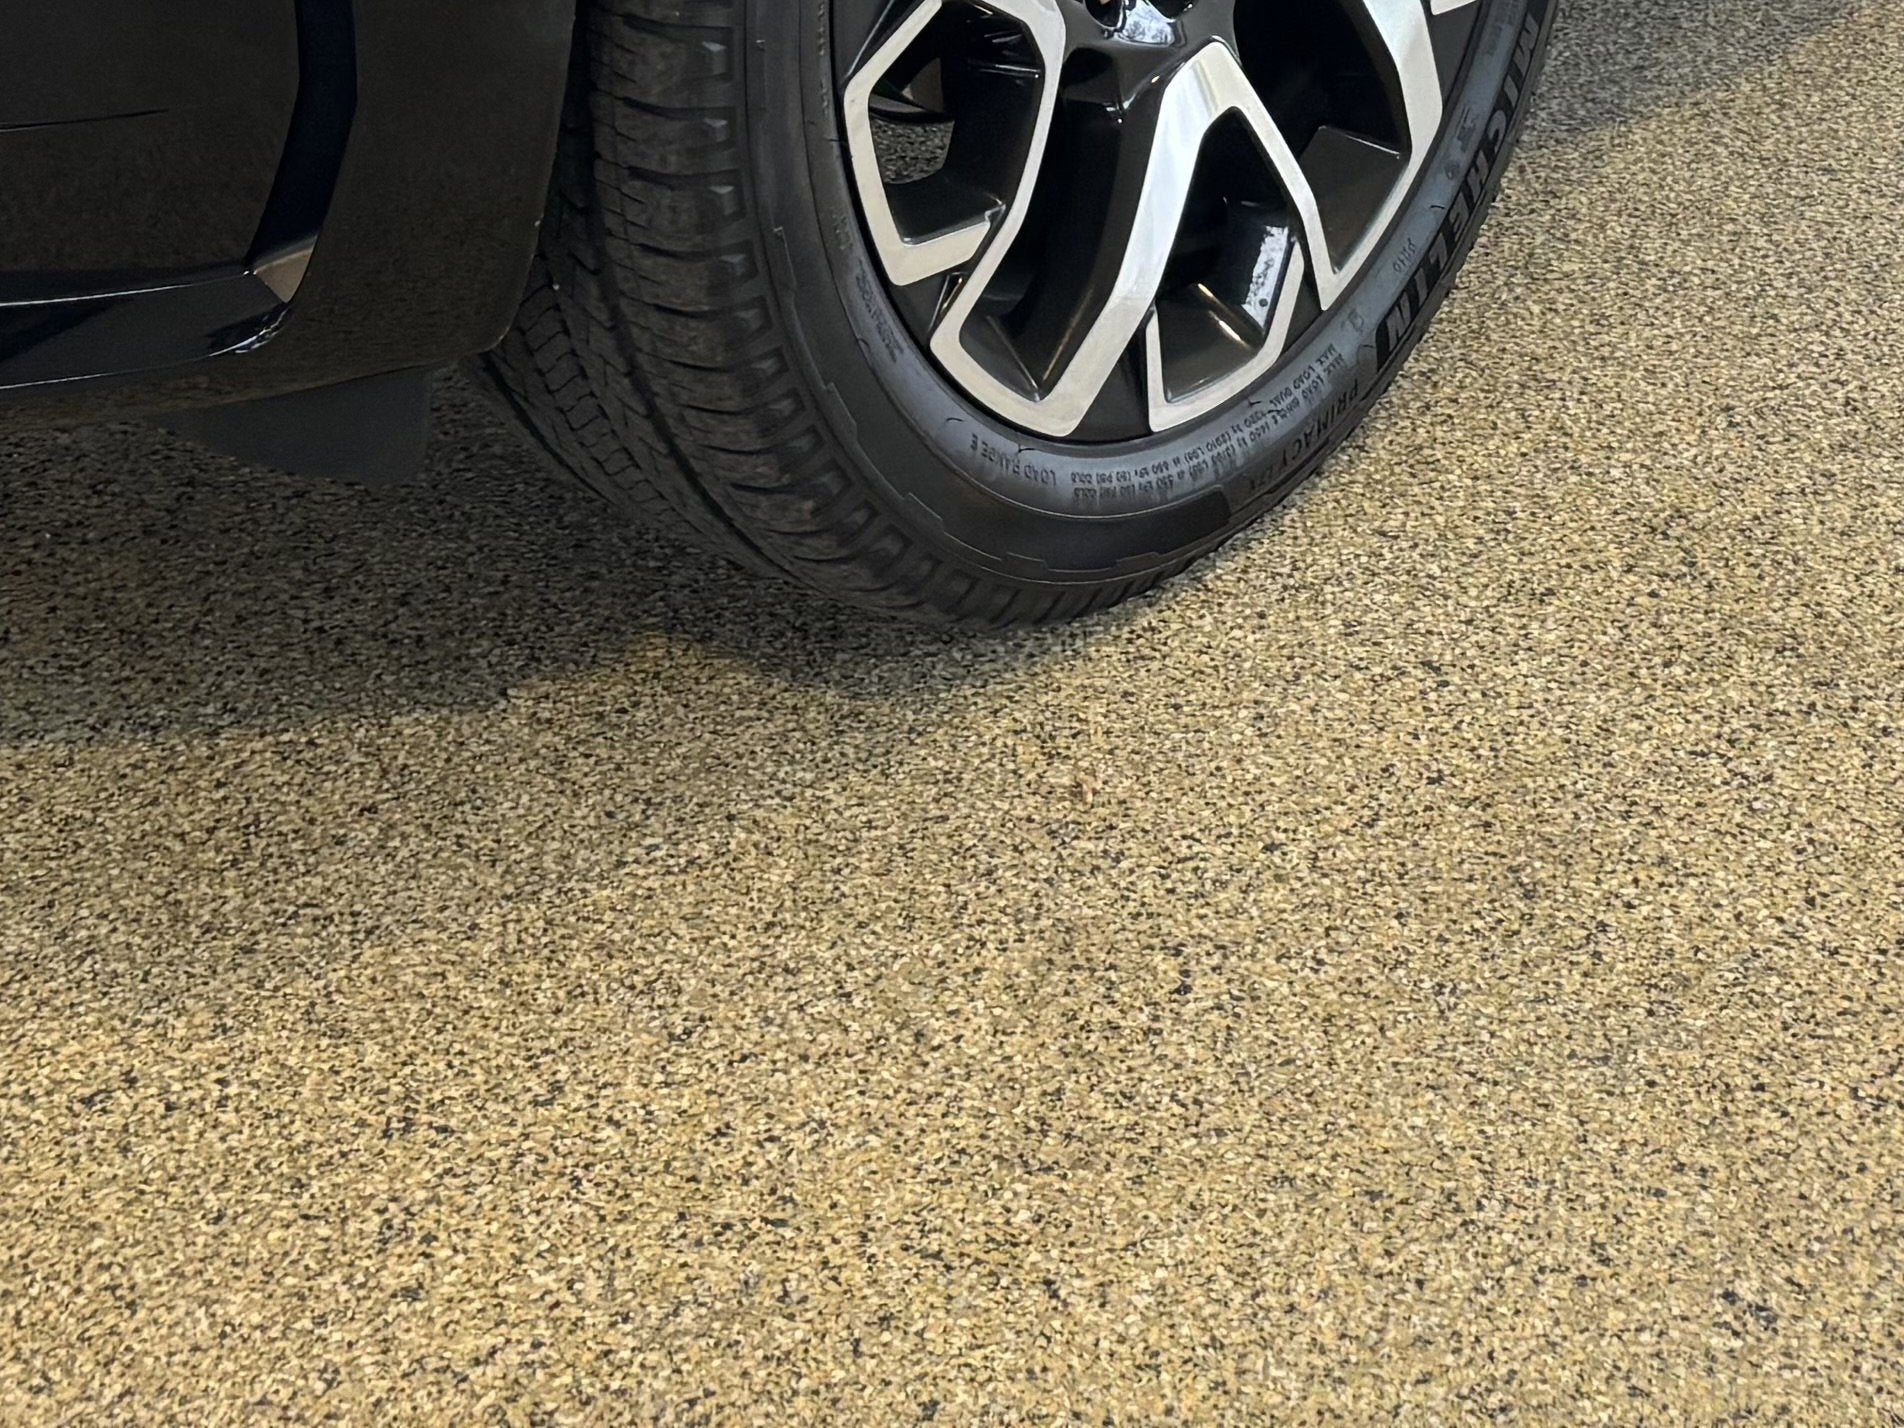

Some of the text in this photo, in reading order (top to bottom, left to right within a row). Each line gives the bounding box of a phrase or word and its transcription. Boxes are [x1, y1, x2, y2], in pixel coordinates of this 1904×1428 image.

[1379, 10, 1547, 353] MICHELIN
[968, 432, 980, 451] E
[1276, 376, 1361, 473] PRIMACY
[1020, 461, 1058, 487] LOAD
